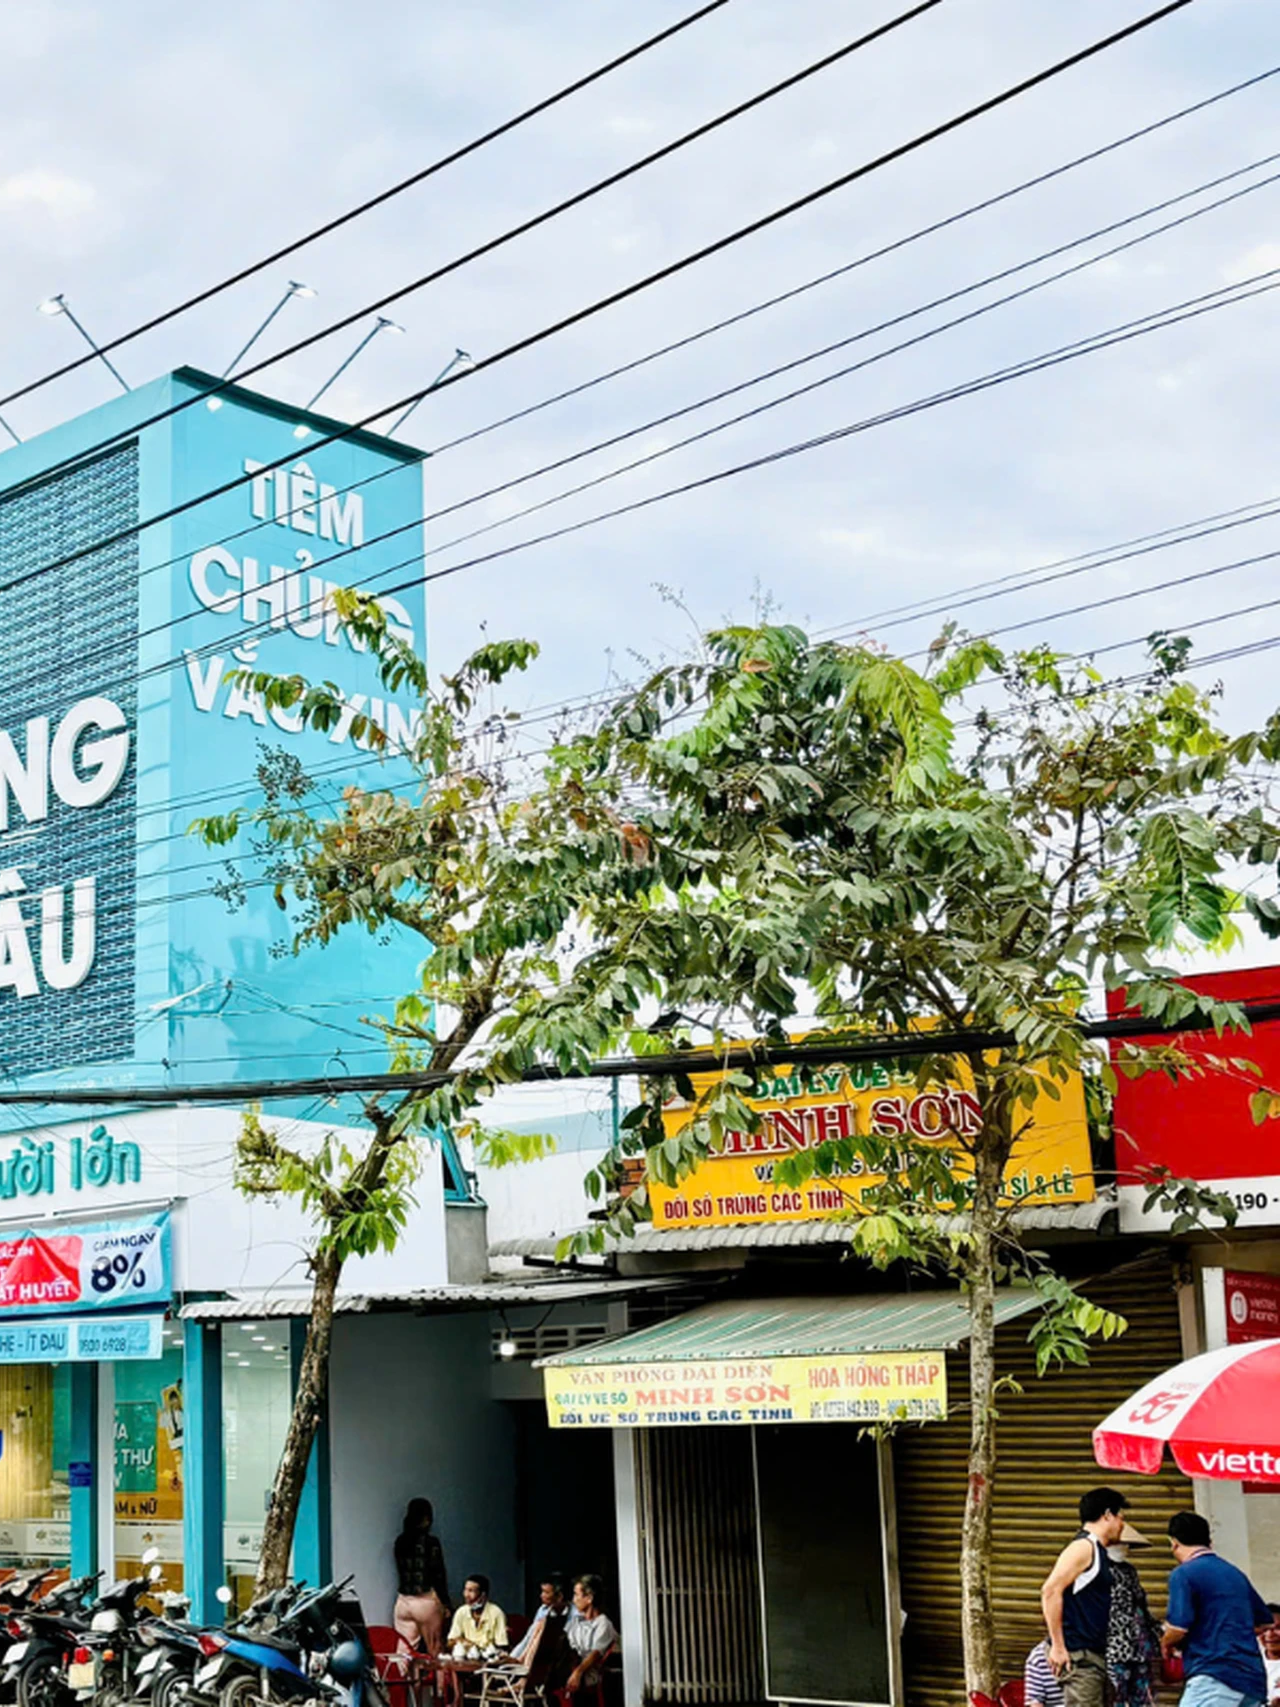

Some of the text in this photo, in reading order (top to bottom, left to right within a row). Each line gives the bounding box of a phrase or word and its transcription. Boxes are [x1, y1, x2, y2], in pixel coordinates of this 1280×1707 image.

[243, 457, 365, 549] TIÊM
[871, 1088, 984, 1140] SƠN
[70, 1124, 142, 1190] lớn
[1235, 1192, 1268, 1210] 190
[123, 1232, 157, 1248] NGAY
[91, 1252, 146, 1293] 8%
[20, 1276, 73, 1300] HUYẾT
[635, 1386, 715, 1407] MINH
[724, 1382, 791, 1404] SƠN
[1128, 1391, 1189, 1425] 5G
[1196, 1449, 1280, 1475] viette
[139, 1497, 158, 1515] NỮ
